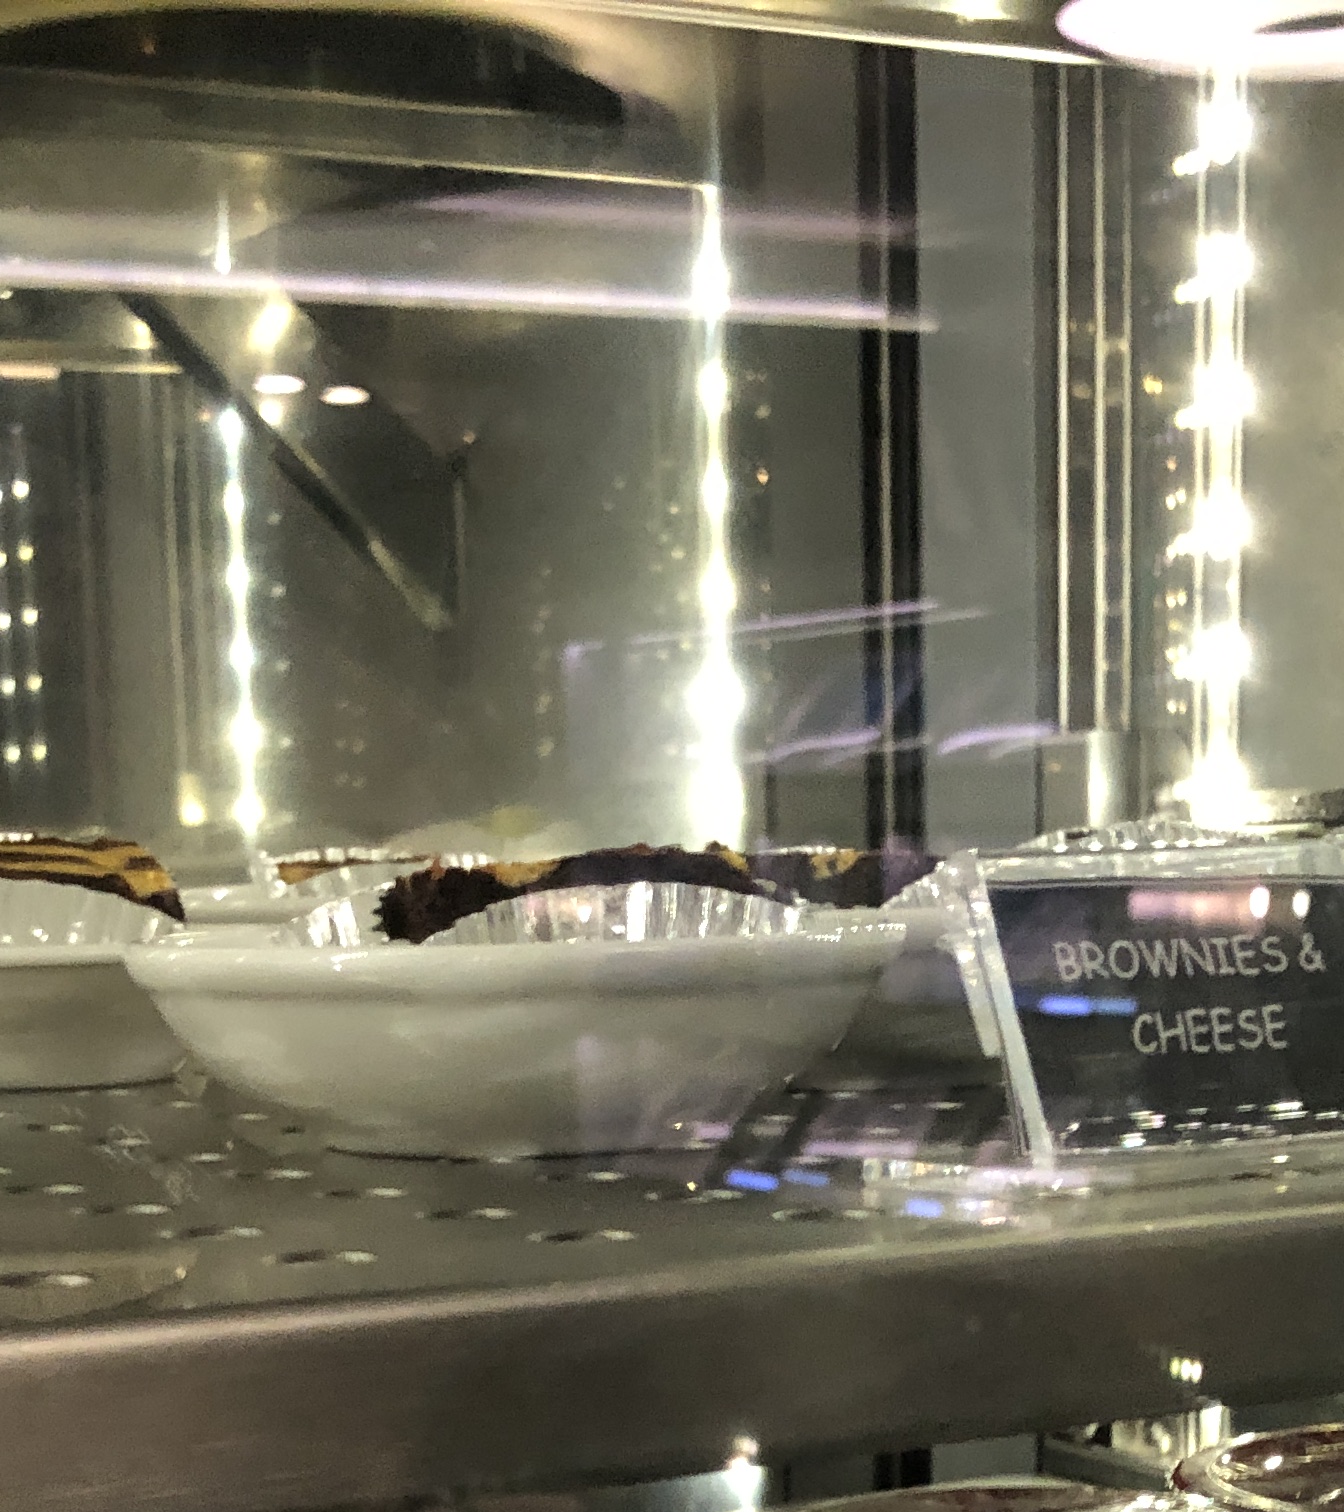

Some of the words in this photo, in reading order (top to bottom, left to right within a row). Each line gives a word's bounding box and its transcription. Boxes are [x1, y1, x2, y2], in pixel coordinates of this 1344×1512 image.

[1053, 936, 1290, 983] BROWNIES
[1298, 931, 1327, 973] &
[1131, 1003, 1290, 1056] CHEESE
